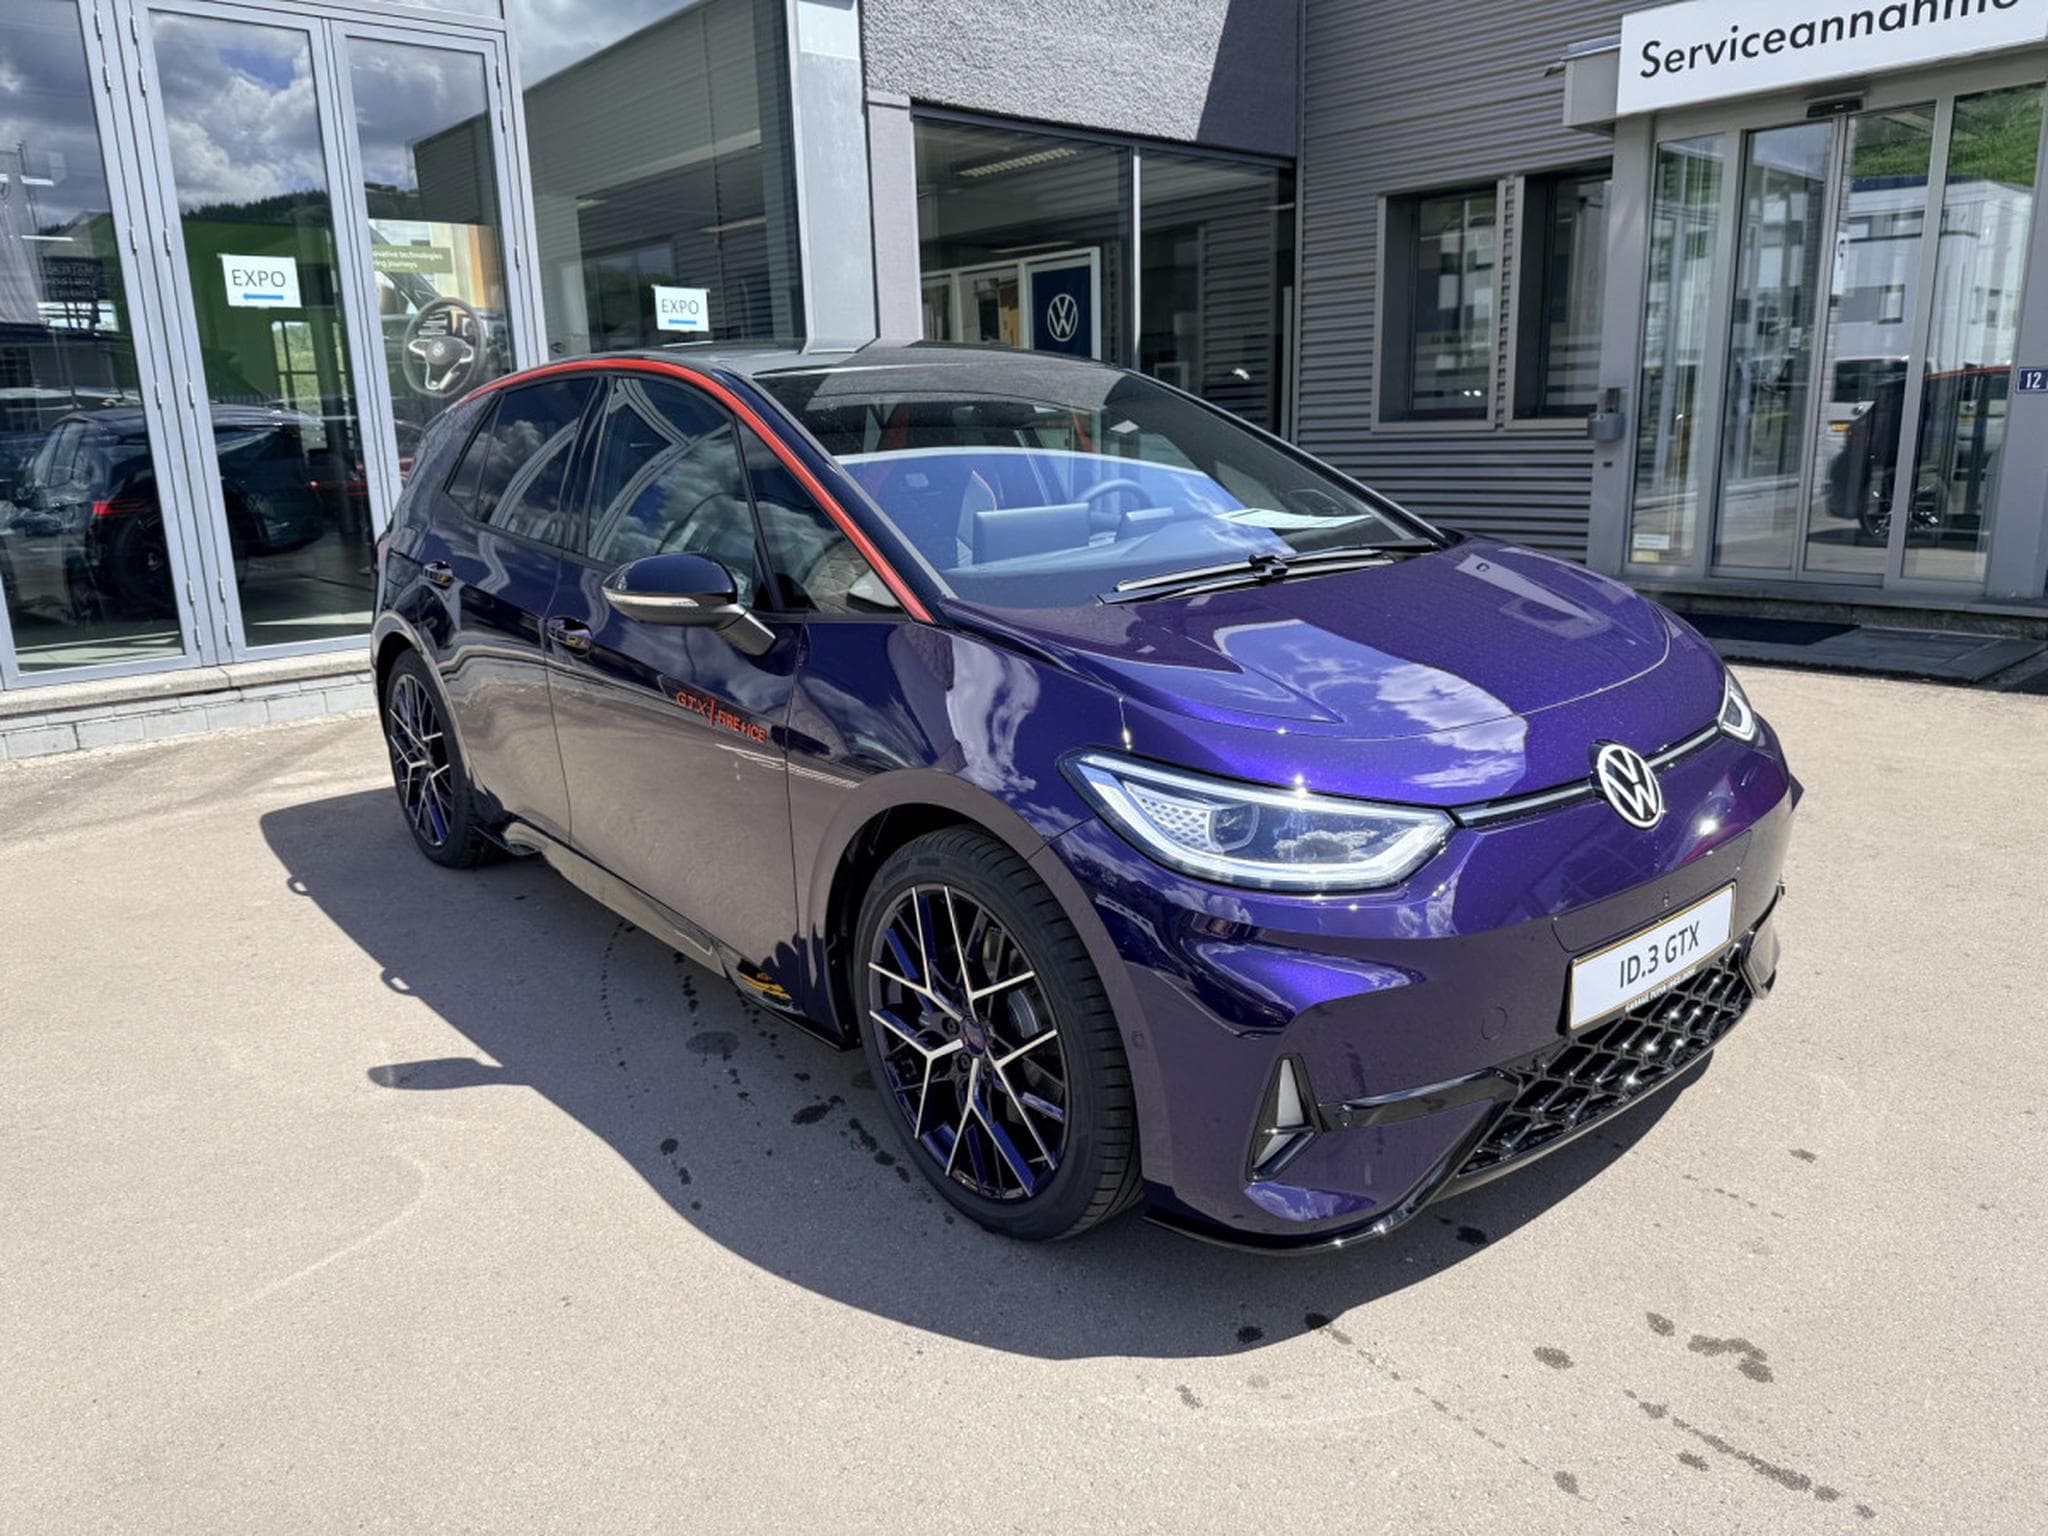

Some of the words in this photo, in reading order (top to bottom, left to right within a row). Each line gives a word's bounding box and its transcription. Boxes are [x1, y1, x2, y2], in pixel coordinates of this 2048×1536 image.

[231, 269, 286, 288] EXPO
[661, 298, 700, 315] EXPO
[1047, 294, 1078, 341] VW
[2026, 372, 2042, 388] 12
[676, 691, 707, 716] GTX
[1598, 745, 1661, 827] VW
[1620, 944, 1659, 989] ID.3
[1665, 920, 1700, 964] GTX
